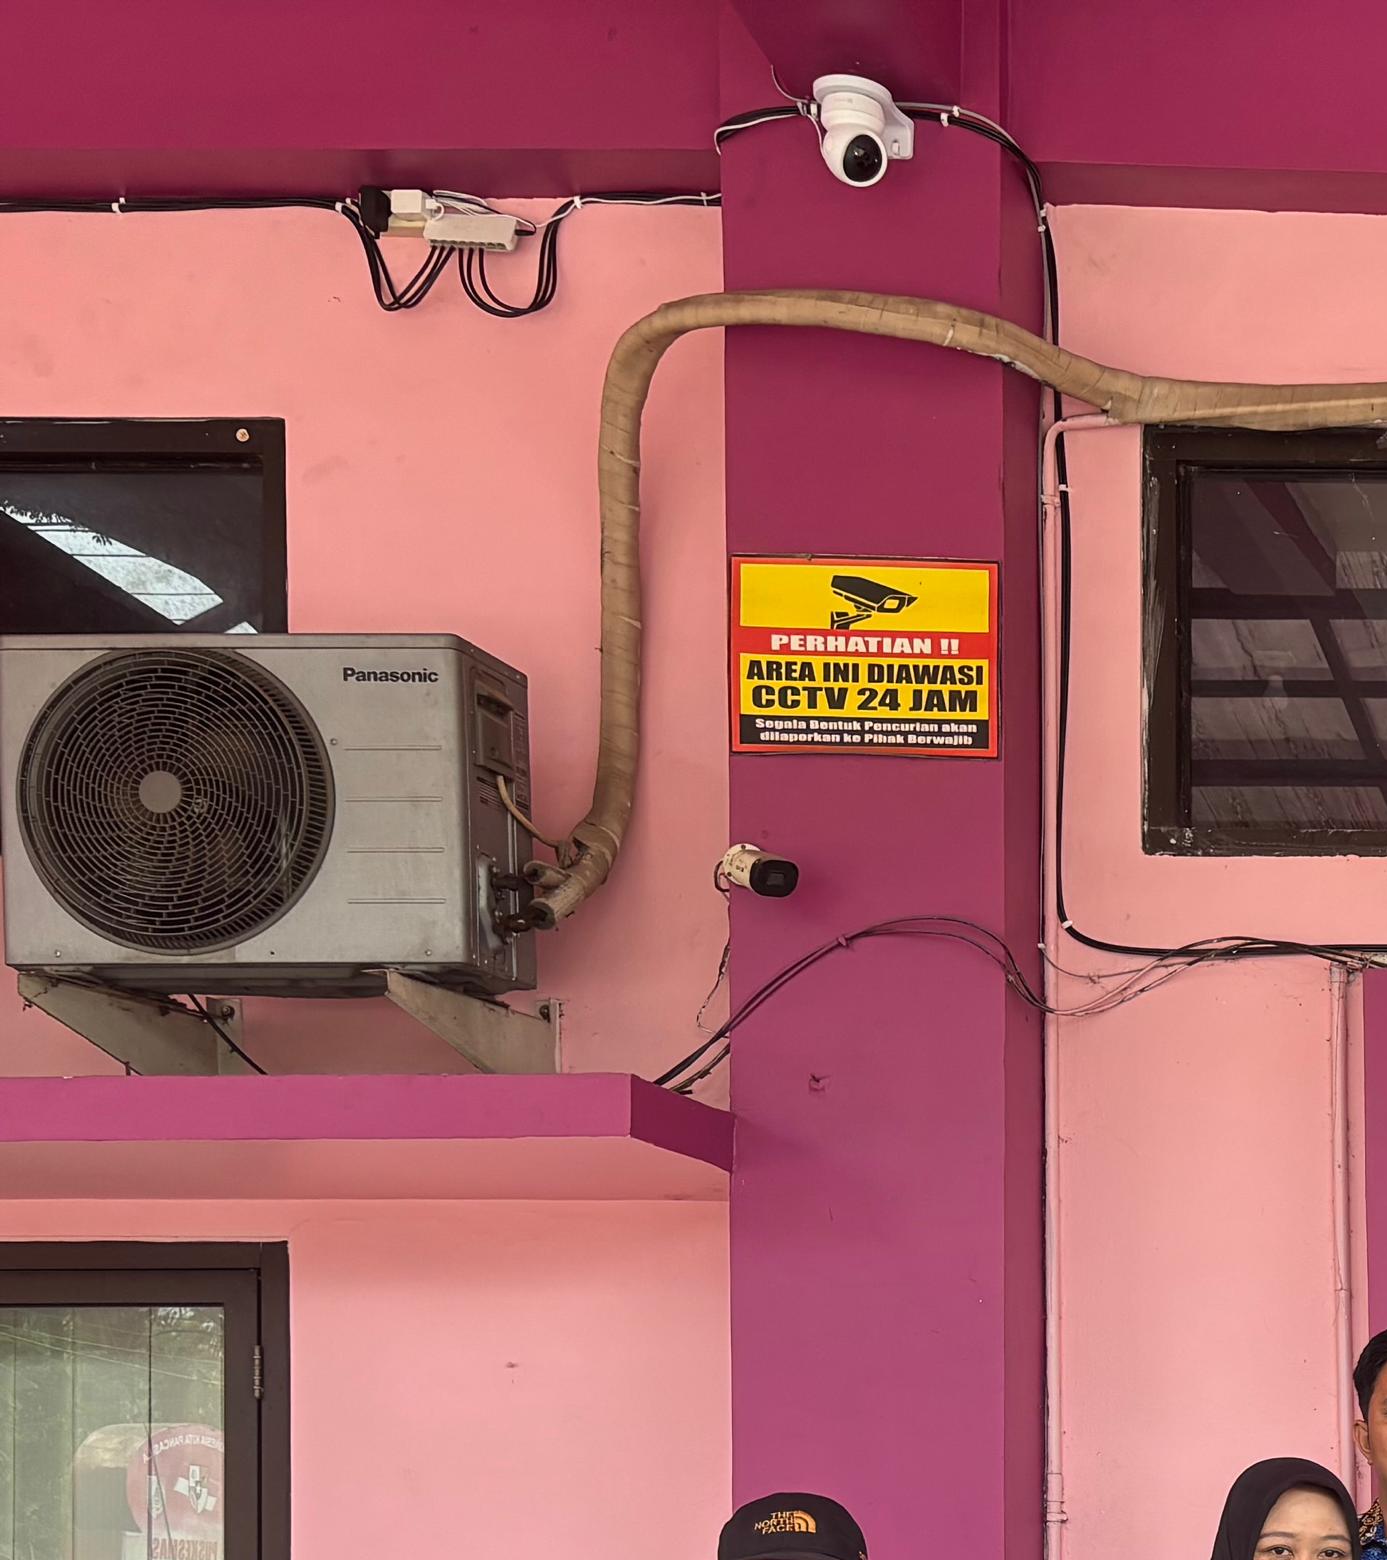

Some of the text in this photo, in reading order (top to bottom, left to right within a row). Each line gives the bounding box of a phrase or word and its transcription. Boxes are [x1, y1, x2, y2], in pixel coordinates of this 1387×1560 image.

[771, 634, 960, 655] PERHATIAN !!
[342, 667, 440, 683] Panasonic
[746, 659, 984, 686] AREA INI DIAWASI
[751, 685, 978, 712] CCTV 24 JAM
[755, 718, 977, 733] Segala Bentuk Pencurian akan
[760, 731, 973, 746] dilaporkan ke Pihak Berwajib
